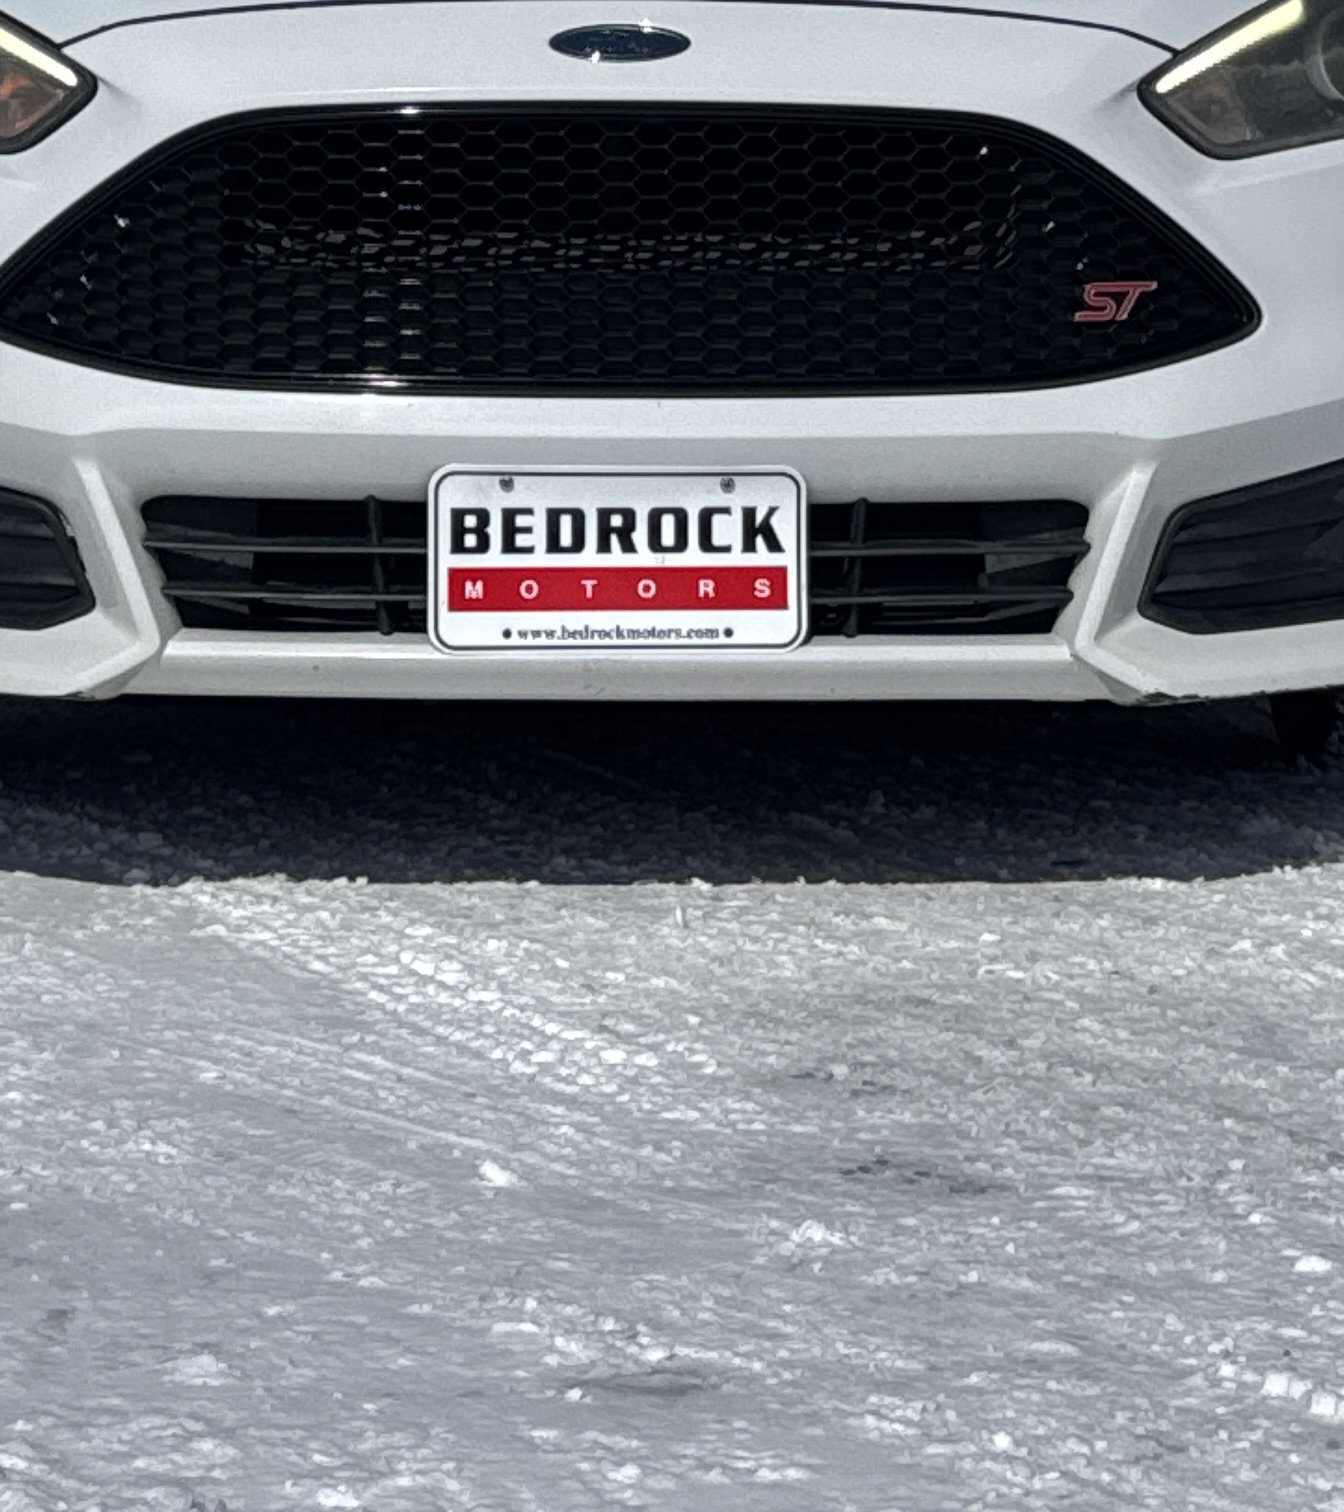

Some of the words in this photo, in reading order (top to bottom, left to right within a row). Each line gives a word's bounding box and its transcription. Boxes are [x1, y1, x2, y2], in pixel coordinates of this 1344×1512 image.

[1073, 280, 1158, 322] ST
[449, 506, 786, 555] BEDROCK
[464, 578, 772, 600] MOTORS
[517, 624, 720, 641] www.bedrockmotors.com
